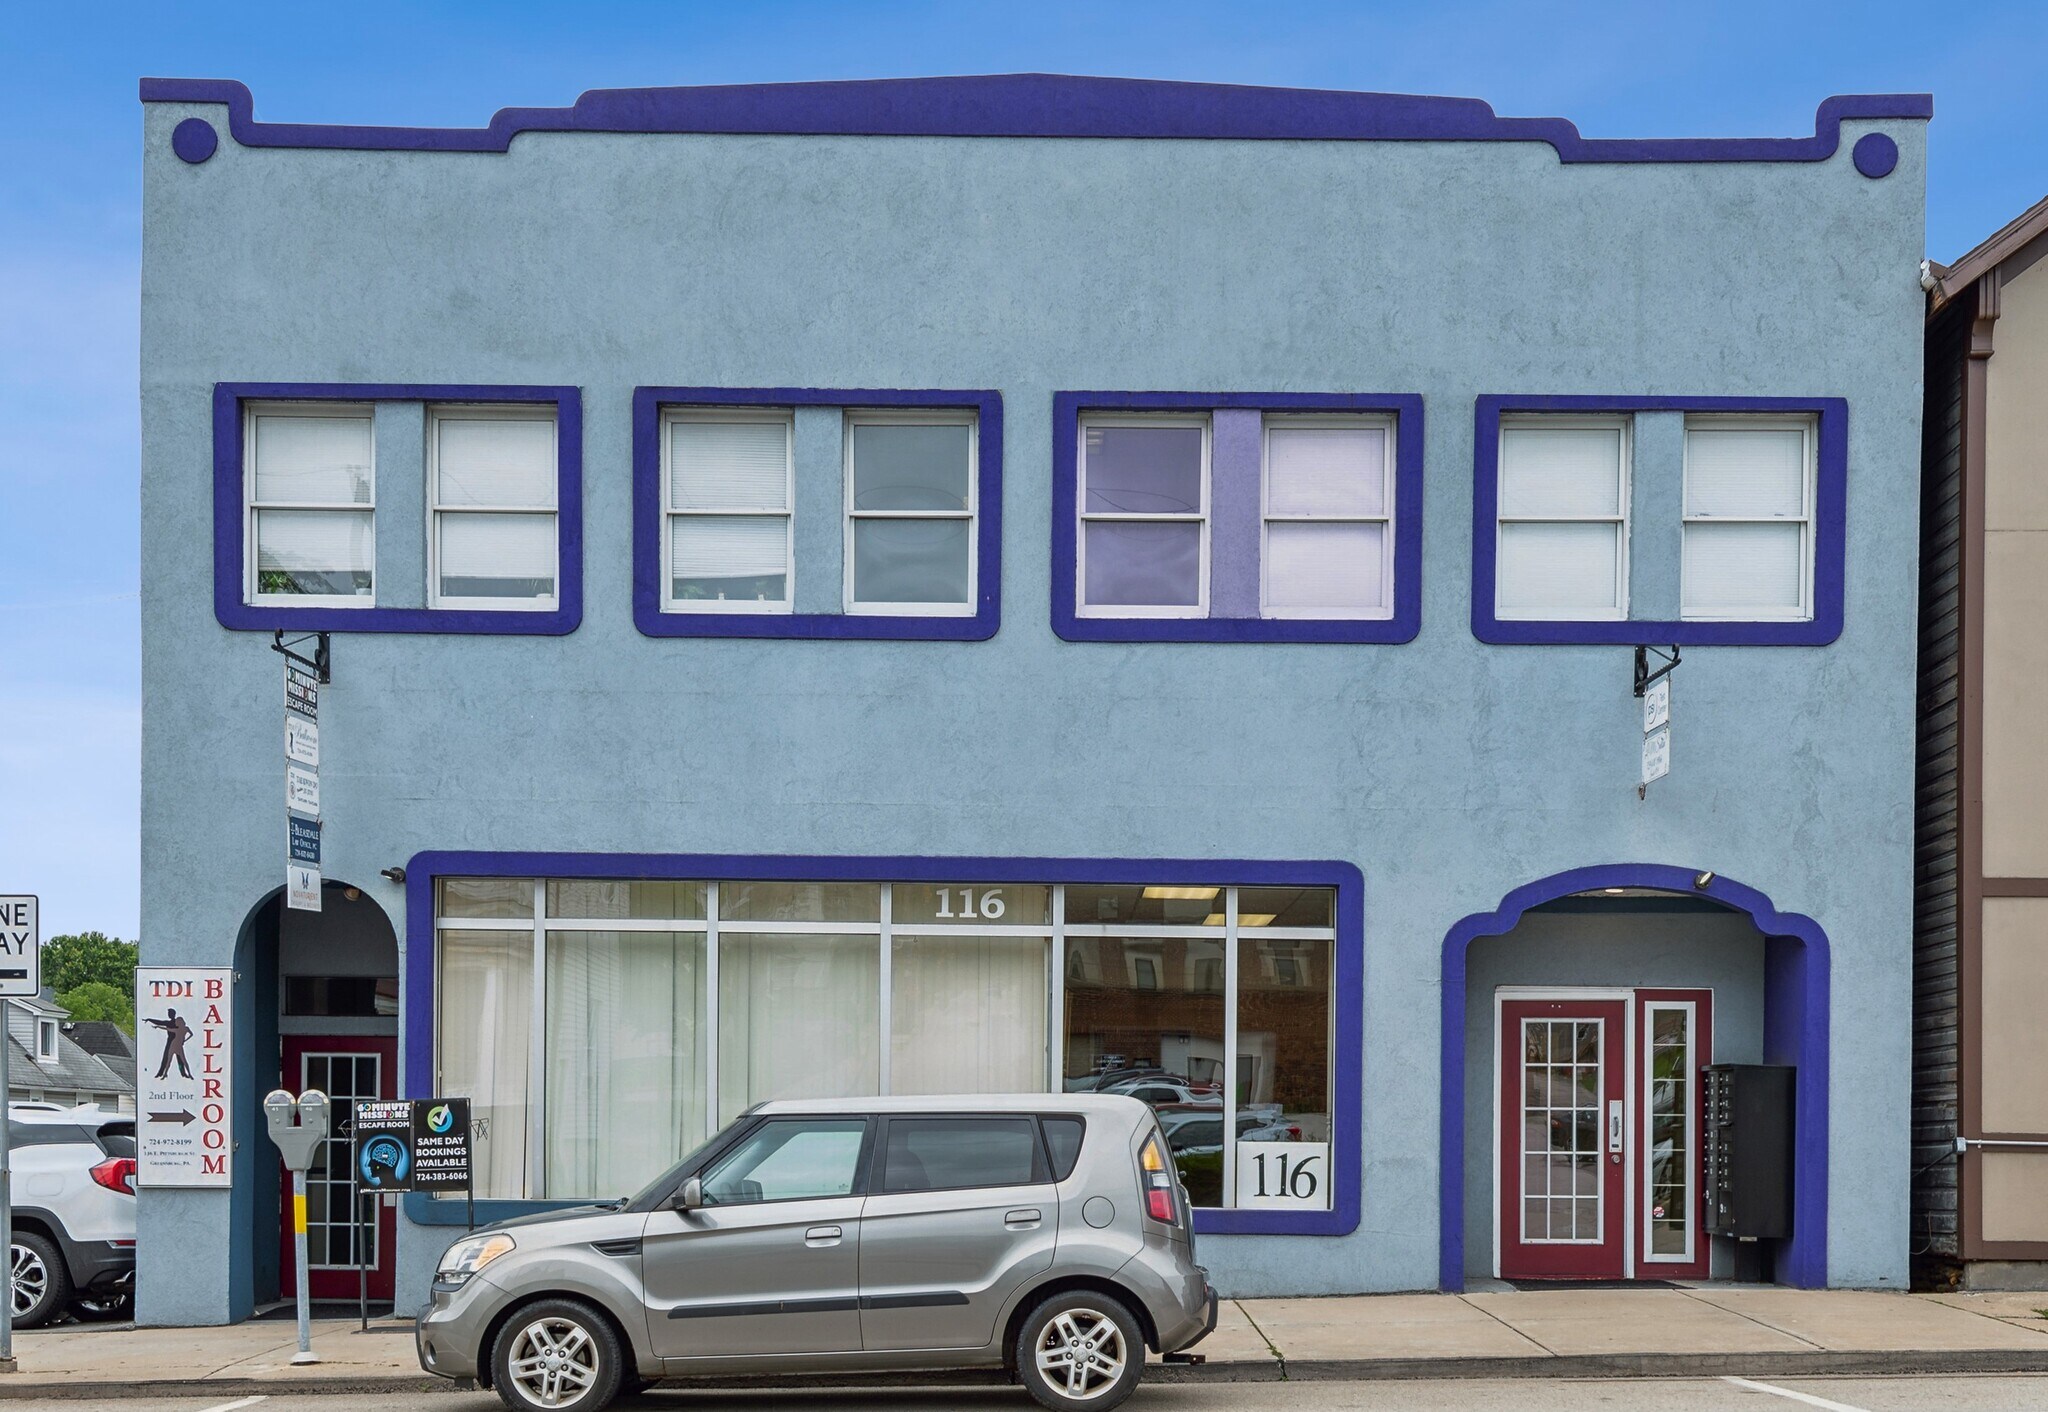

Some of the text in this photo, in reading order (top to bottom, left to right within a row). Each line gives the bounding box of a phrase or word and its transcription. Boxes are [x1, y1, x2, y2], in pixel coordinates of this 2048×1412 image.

[287, 680, 317, 704] MISSIONS
[287, 696, 304, 712] ESCAPE
[935, 888, 1006, 919] 116
[0, 903, 28, 927] NE
[0, 932, 30, 956] AY
[149, 980, 193, 998] TDI
[201, 979, 227, 1175] BALLROOM
[148, 1091, 195, 1101] 2nd Floor
[359, 1110, 409, 1119] MISSIONS
[358, 1121, 386, 1129] ESCAPE
[417, 1137, 465, 1146] SAME DAY
[415, 1147, 467, 1157] BOOKINGS
[415, 1158, 468, 1168] AVAILABLE
[416, 1172, 468, 1181] 724-383-6066
[1252, 1152, 1321, 1199] 116
